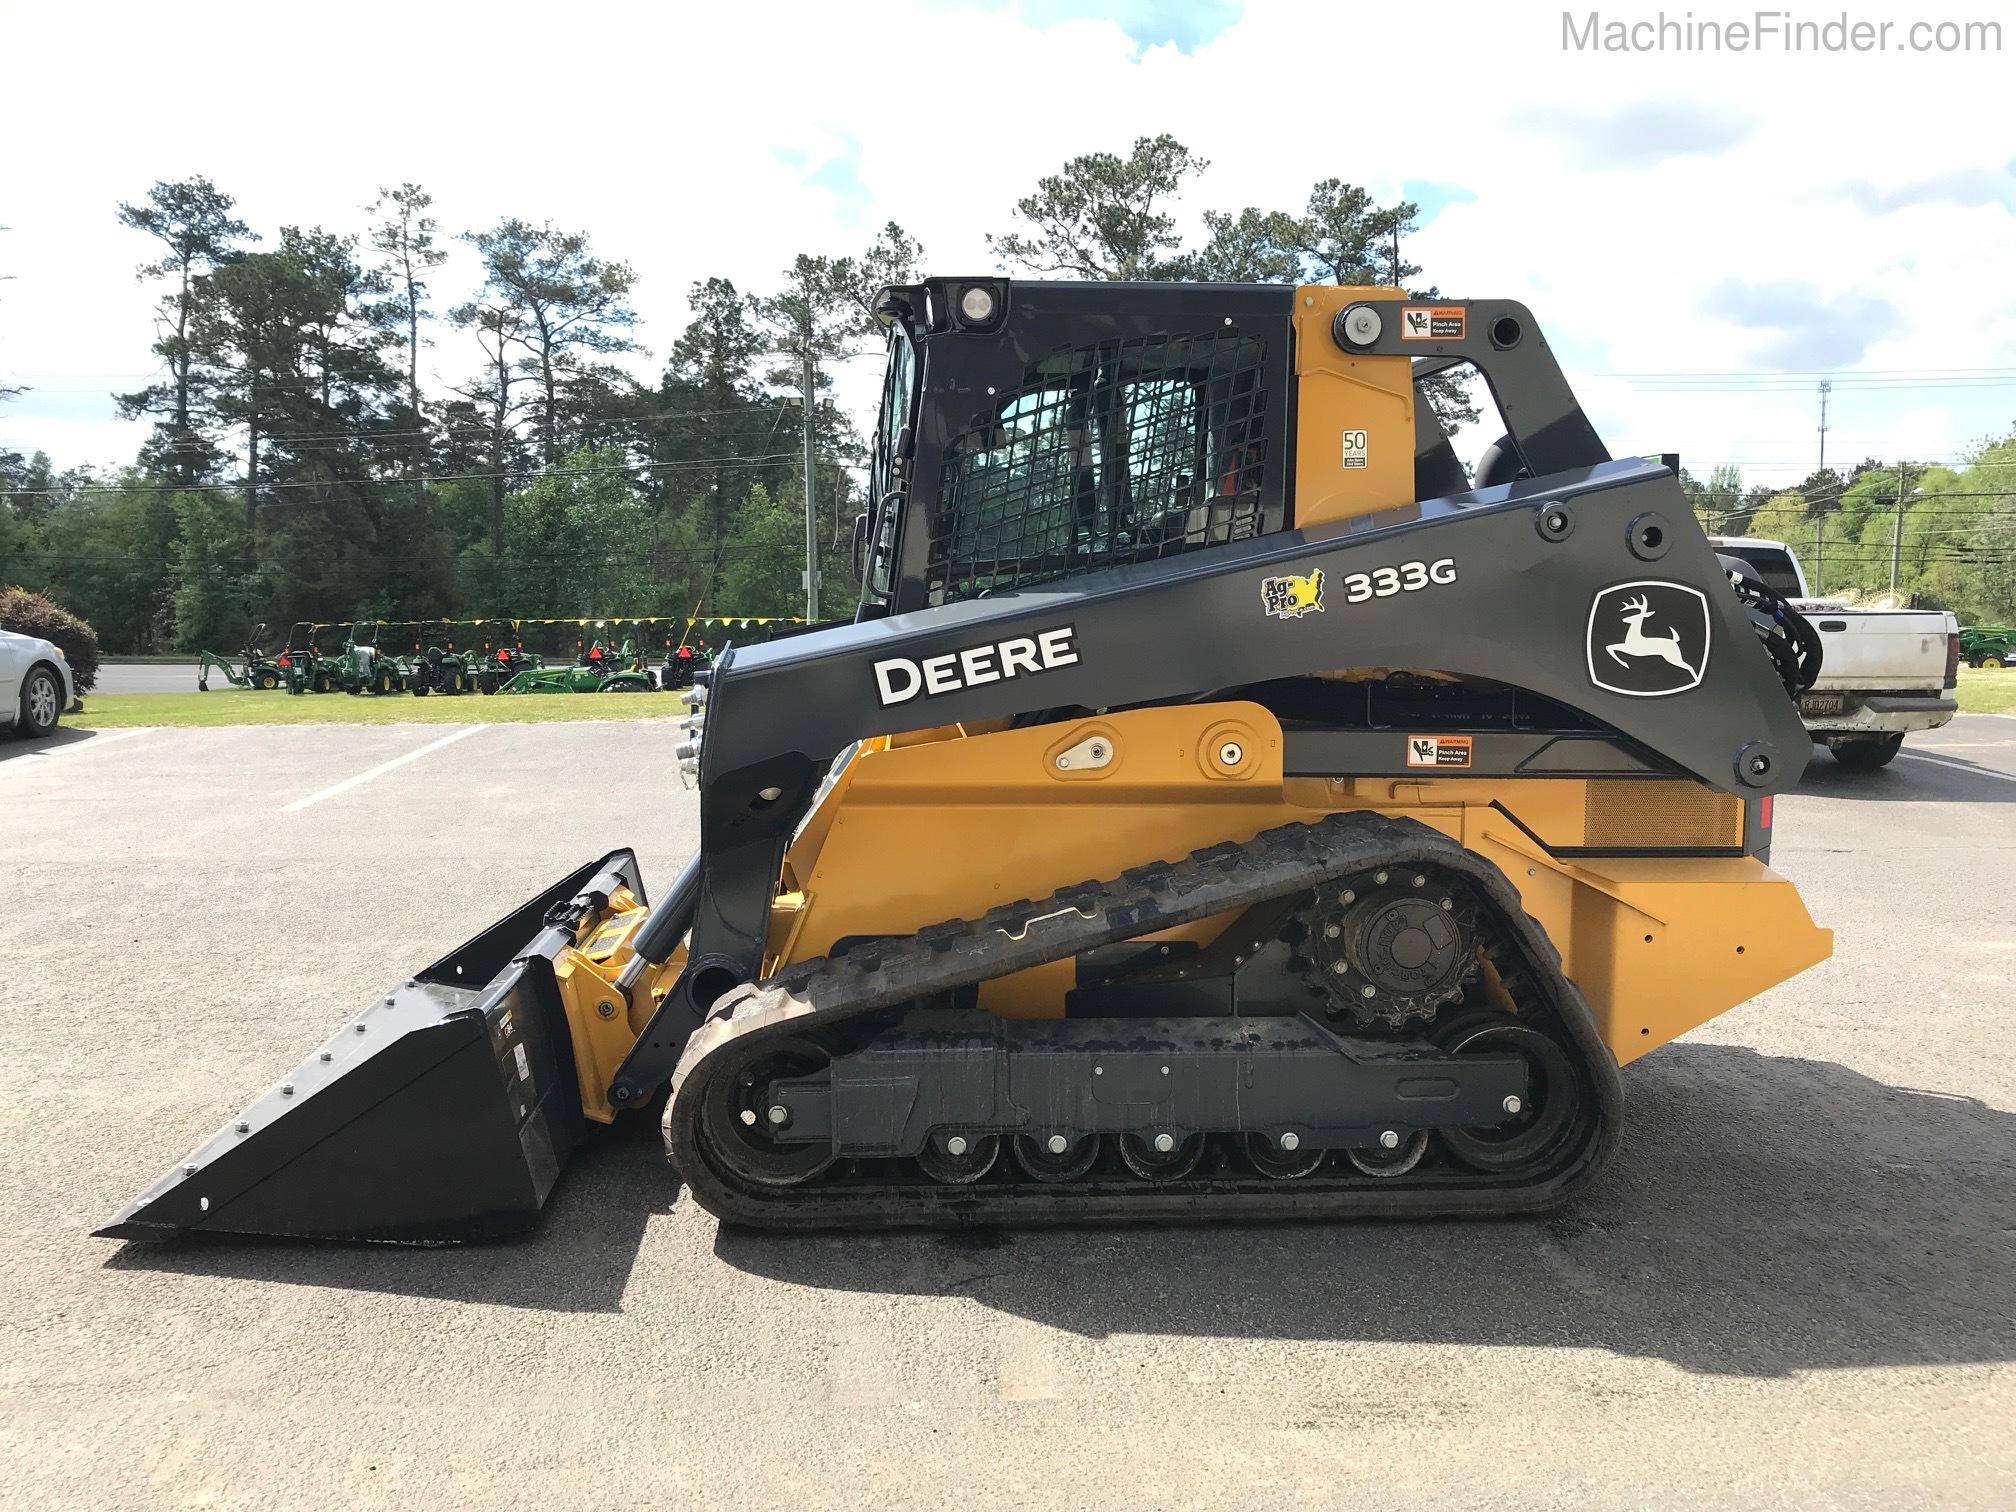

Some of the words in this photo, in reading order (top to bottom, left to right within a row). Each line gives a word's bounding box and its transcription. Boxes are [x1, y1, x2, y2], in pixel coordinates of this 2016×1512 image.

[1344, 432, 1365, 450] 50
[1265, 580, 1294, 597] Ag-
[1343, 558, 1457, 603] 333G
[1268, 595, 1298, 612] Pro
[873, 627, 1079, 706] DEERE
